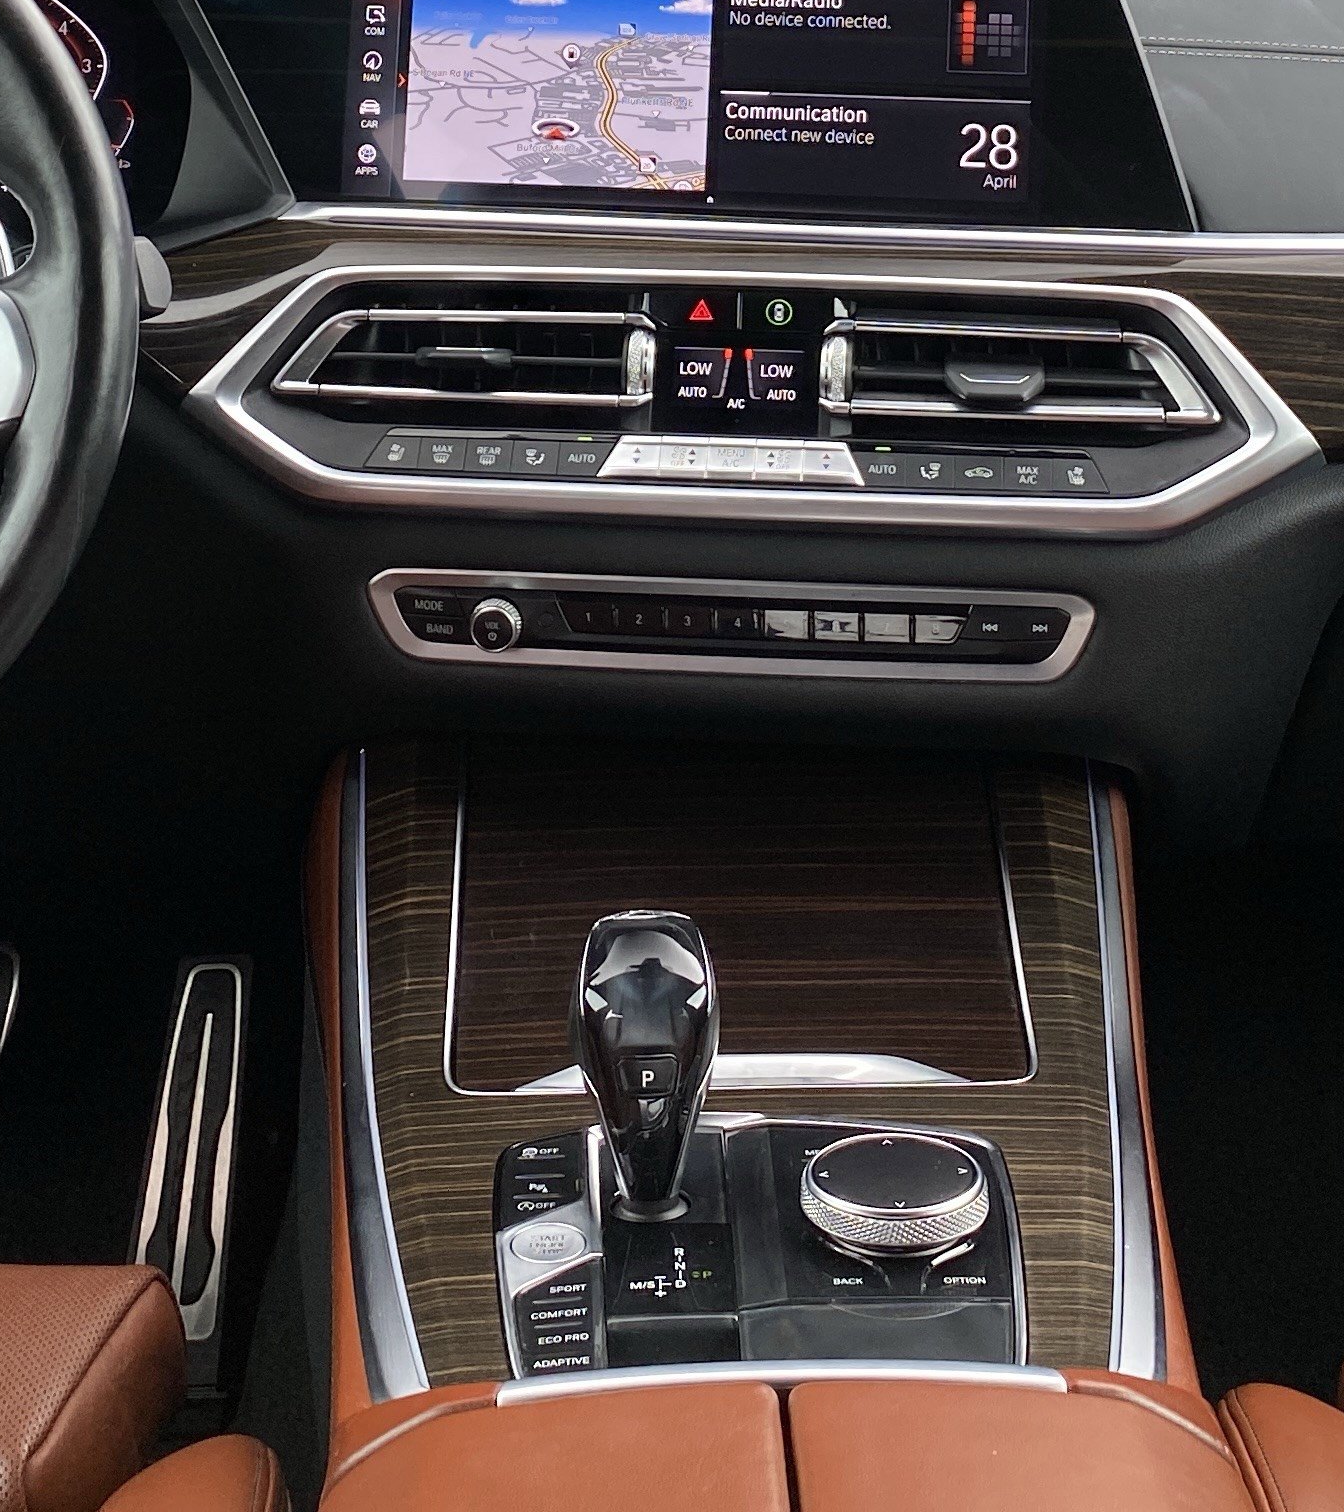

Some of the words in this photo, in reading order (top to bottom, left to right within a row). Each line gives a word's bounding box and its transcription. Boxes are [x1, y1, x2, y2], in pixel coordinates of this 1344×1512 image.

[729, 11, 751, 26] No
[754, 11, 804, 28] device
[807, 13, 892, 30] connected.
[58, 21, 68, 36] 4
[364, 27, 386, 36] COM
[82, 58, 92, 74] 3
[362, 73, 382, 83] NAV
[725, 102, 868, 124] Communication
[360, 120, 379, 129] CAR
[724, 125, 788, 142] Connect
[791, 130, 822, 143] new
[825, 128, 876, 145] device
[959, 123, 1019, 170] 28
[355, 167, 379, 176] APPS
[983, 174, 1018, 191] April
[679, 361, 713, 376] LOW
[760, 364, 794, 378] LOW
[678, 386, 708, 398] AUTO
[767, 389, 796, 401] AUTO
[727, 398, 746, 410] A/C
[432, 444, 454, 455] MAX
[476, 445, 502, 457] REAR
[717, 449, 746, 458] MENU
[568, 453, 596, 465] AUTO
[722, 459, 740, 468] A/C
[868, 463, 897, 476] AUTO
[1016, 465, 1039, 476] MAX
[1018, 473, 1039, 486] A/C
[415, 599, 444, 612] MODE
[484, 621, 499, 630] VOL
[585, 612, 591, 624] 1
[635, 613, 644, 626] 2
[683, 615, 692, 628] 3
[734, 616, 742, 628] 4
[426, 623, 454, 635] BAND
[641, 1069, 655, 1088] P
[674, 1247, 684, 1256] R
[674, 1261, 686, 1270] N
[629, 1280, 656, 1290] M/S
[675, 1279, 686, 1288] D
[833, 1277, 864, 1286] BACK
[943, 1276, 986, 1286] OPTION
[549, 1283, 587, 1294] SPORT
[530, 1307, 588, 1320] COMFORT
[538, 1335, 562, 1346] ECO
[564, 1332, 590, 1342] PRO
[533, 1356, 590, 1369] ADAPTIVE
